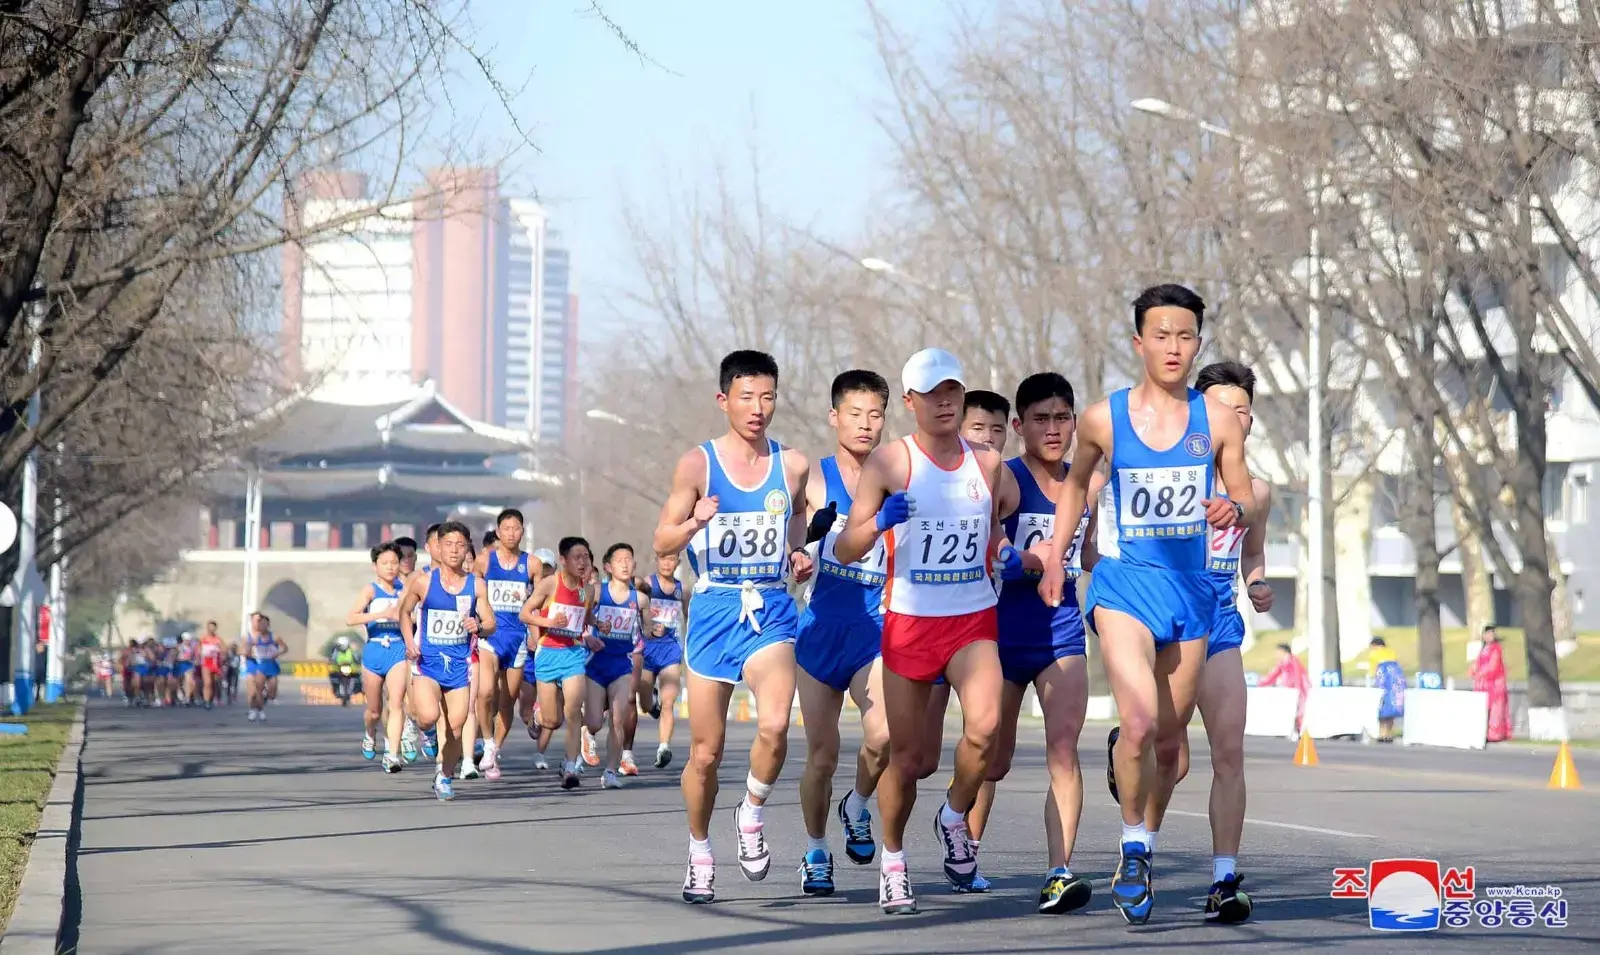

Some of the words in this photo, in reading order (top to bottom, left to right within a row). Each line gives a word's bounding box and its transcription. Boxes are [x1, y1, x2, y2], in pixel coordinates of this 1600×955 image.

[1131, 484, 1197, 518] 082
[719, 528, 778, 558] 038
[921, 532, 979, 565] 125
[433, 619, 464, 635] 098
